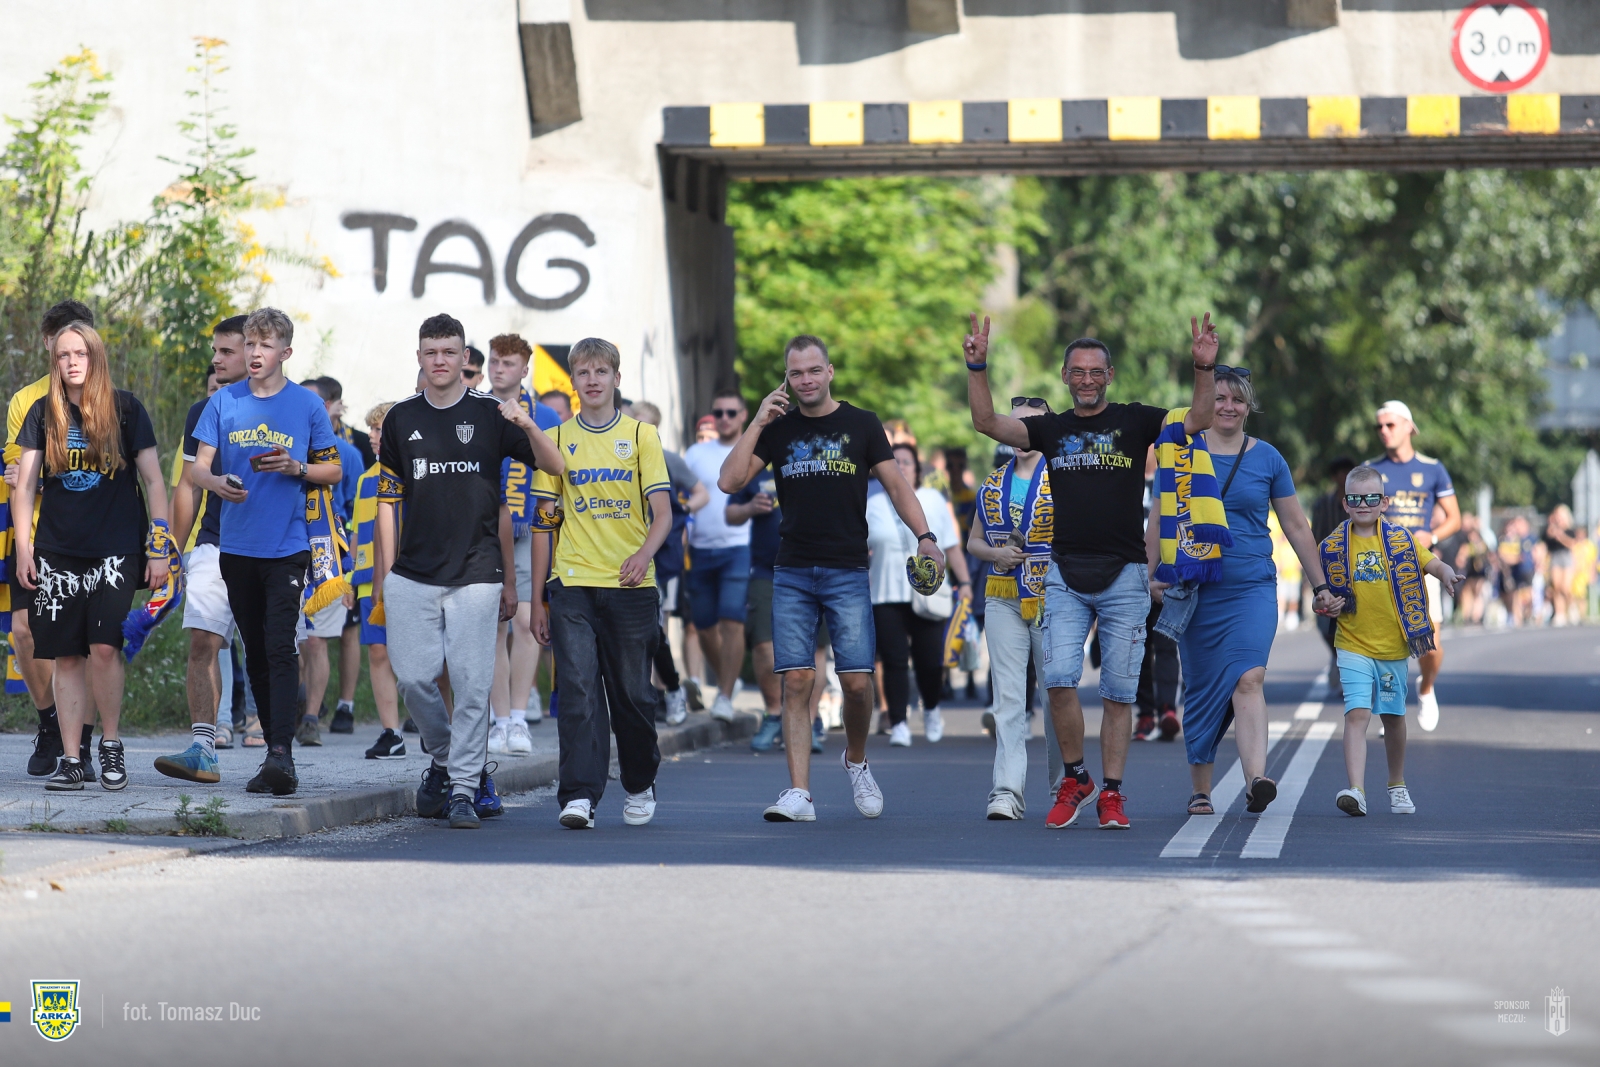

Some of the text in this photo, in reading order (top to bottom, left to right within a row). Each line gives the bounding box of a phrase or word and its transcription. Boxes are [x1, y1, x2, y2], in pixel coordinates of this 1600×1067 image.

[1517, 42, 1536, 54] m
[339, 212, 596, 311] TAG
[228, 429, 258, 444] FORZA
[265, 430, 294, 449] ARKA
[429, 461, 480, 474] BYTOM
[568, 468, 633, 486] GDYNIA
[985, 489, 1002, 524] SAM
[1387, 529, 1410, 556] NA
[1327, 561, 1346, 587] OD
